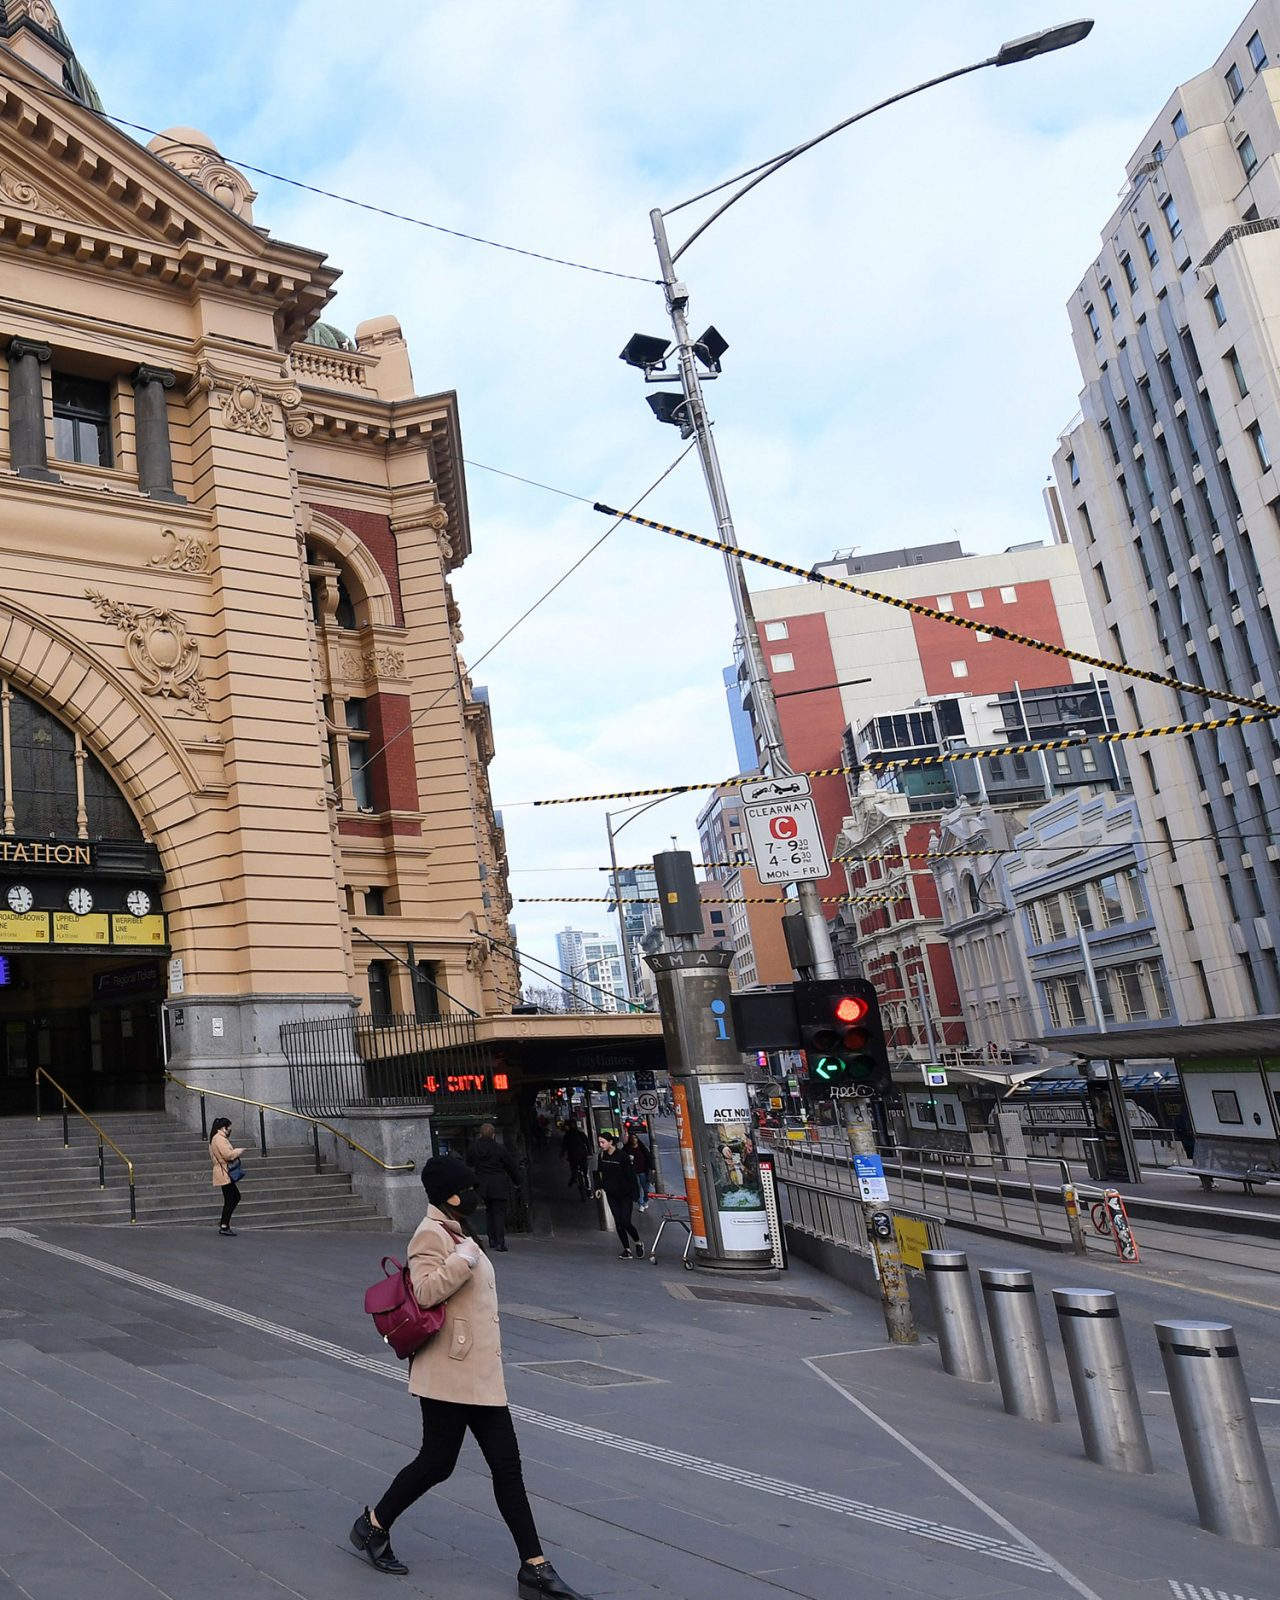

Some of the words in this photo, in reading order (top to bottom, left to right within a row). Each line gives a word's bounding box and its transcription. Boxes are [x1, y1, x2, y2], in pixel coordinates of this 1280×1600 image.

[749, 802, 808, 818] CLEARWAY
[766, 870, 790, 879] MON
[802, 866, 820, 875] FRI
[642, 1098, 655, 1107] 40
[714, 1109, 732, 1118] ACT
